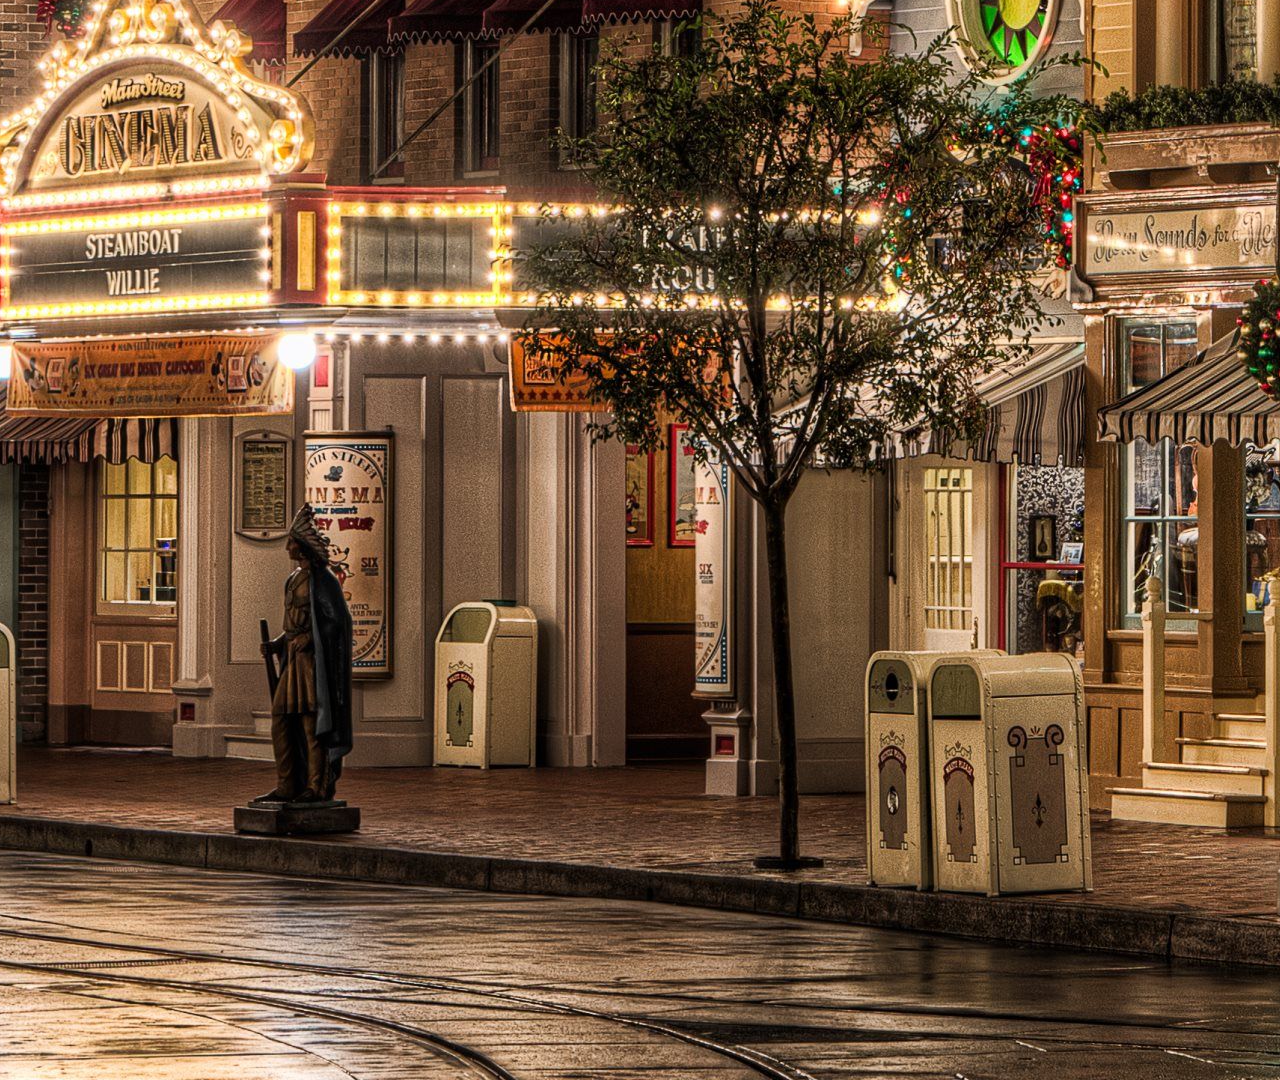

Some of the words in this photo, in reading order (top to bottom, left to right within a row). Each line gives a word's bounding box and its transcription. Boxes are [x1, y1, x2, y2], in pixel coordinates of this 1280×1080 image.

[101, 79, 140, 109] Main
[141, 72, 185, 100] Street
[58, 102, 224, 177] CINEMA
[85, 228, 182, 260] STEAMBOAT
[1094, 219, 1138, 263] New
[1140, 214, 1211, 262] Sounds
[1212, 224, 1229, 247] for
[1241, 211, 1277, 256] Ne
[106, 268, 161, 296] WILLIE
[331, 451, 378, 480] STREET
[305, 486, 384, 504] INEMA
[361, 557, 379, 568] SIX
[698, 563, 713, 575] SIX
